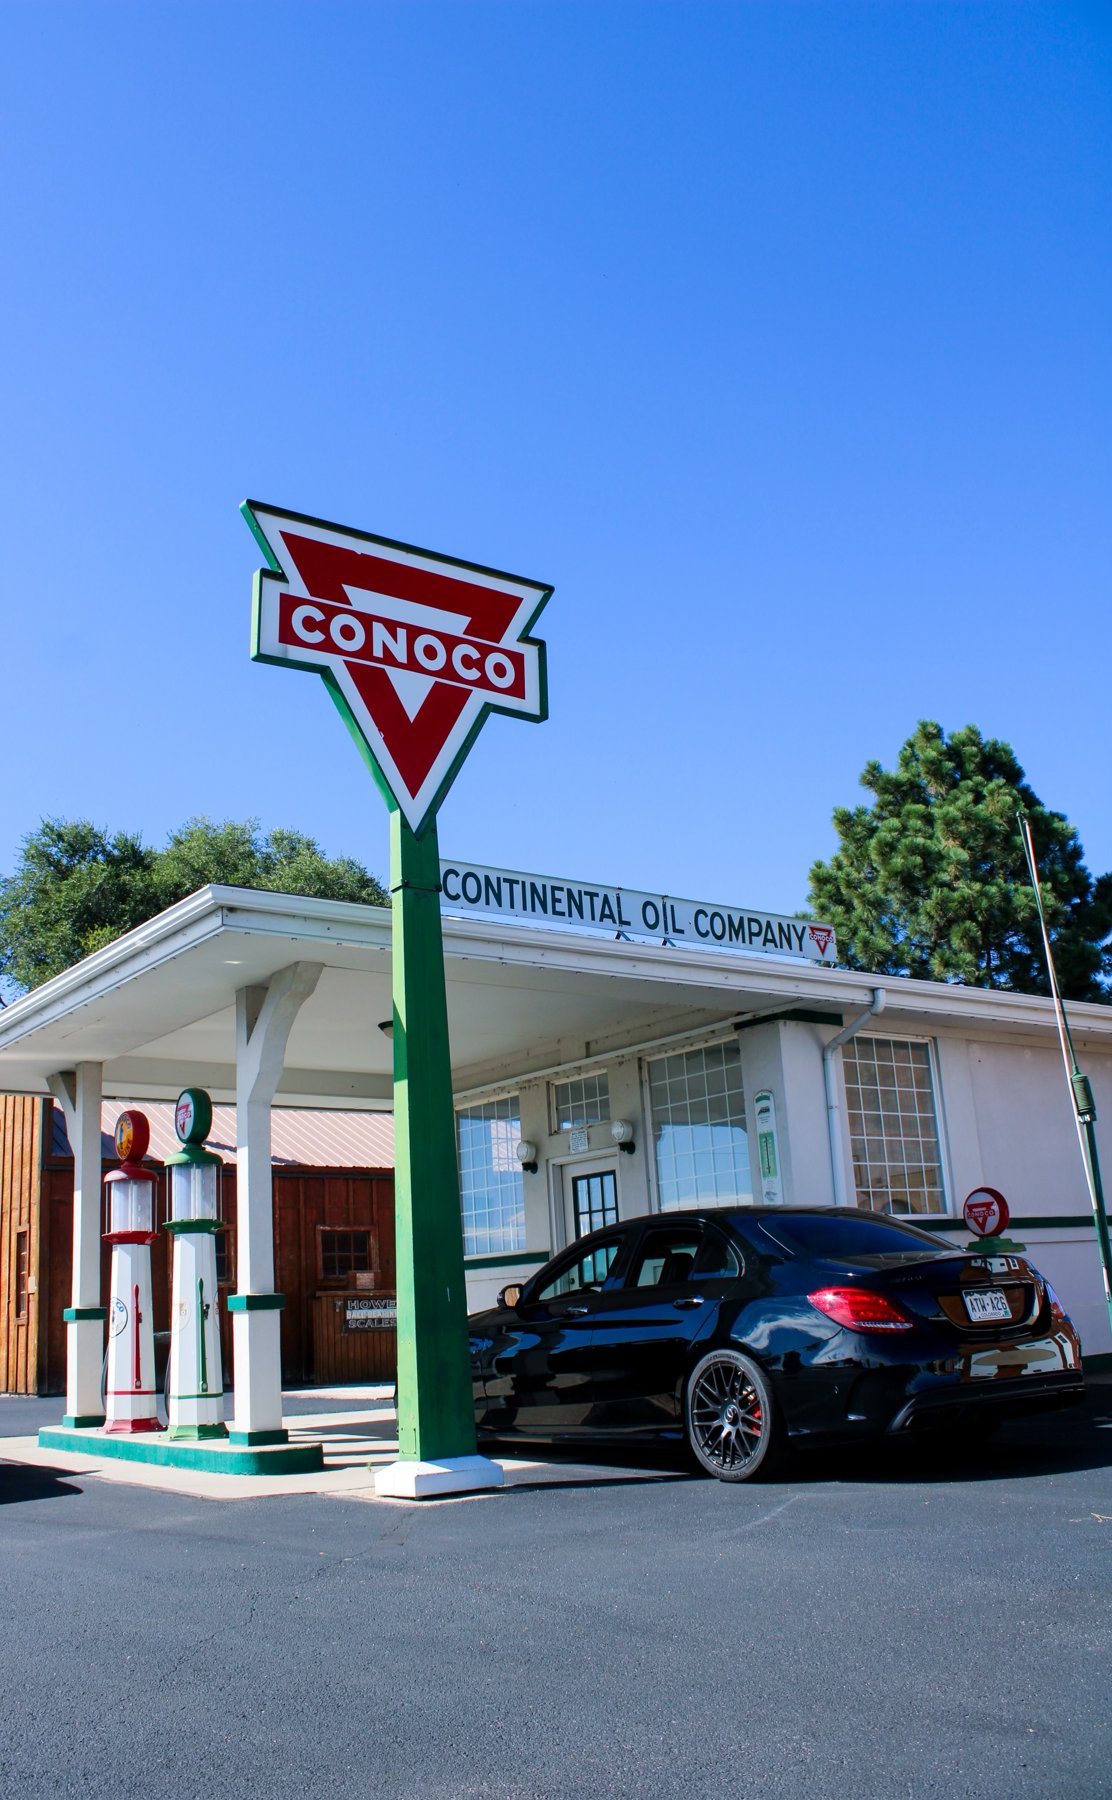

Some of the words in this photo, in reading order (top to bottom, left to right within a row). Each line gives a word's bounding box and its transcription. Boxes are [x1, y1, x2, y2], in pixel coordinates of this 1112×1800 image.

[291, 604, 516, 690] CONOCO
[442, 870, 631, 927] CONTINENTAL
[641, 897, 685, 935] OIL
[694, 909, 807, 952] COMPANY
[810, 933, 834, 943] CONOCO
[967, 1209, 994, 1218] CONOCO
[347, 1299, 397, 1310] HOWE
[349, 1318, 397, 1328] SCALES
